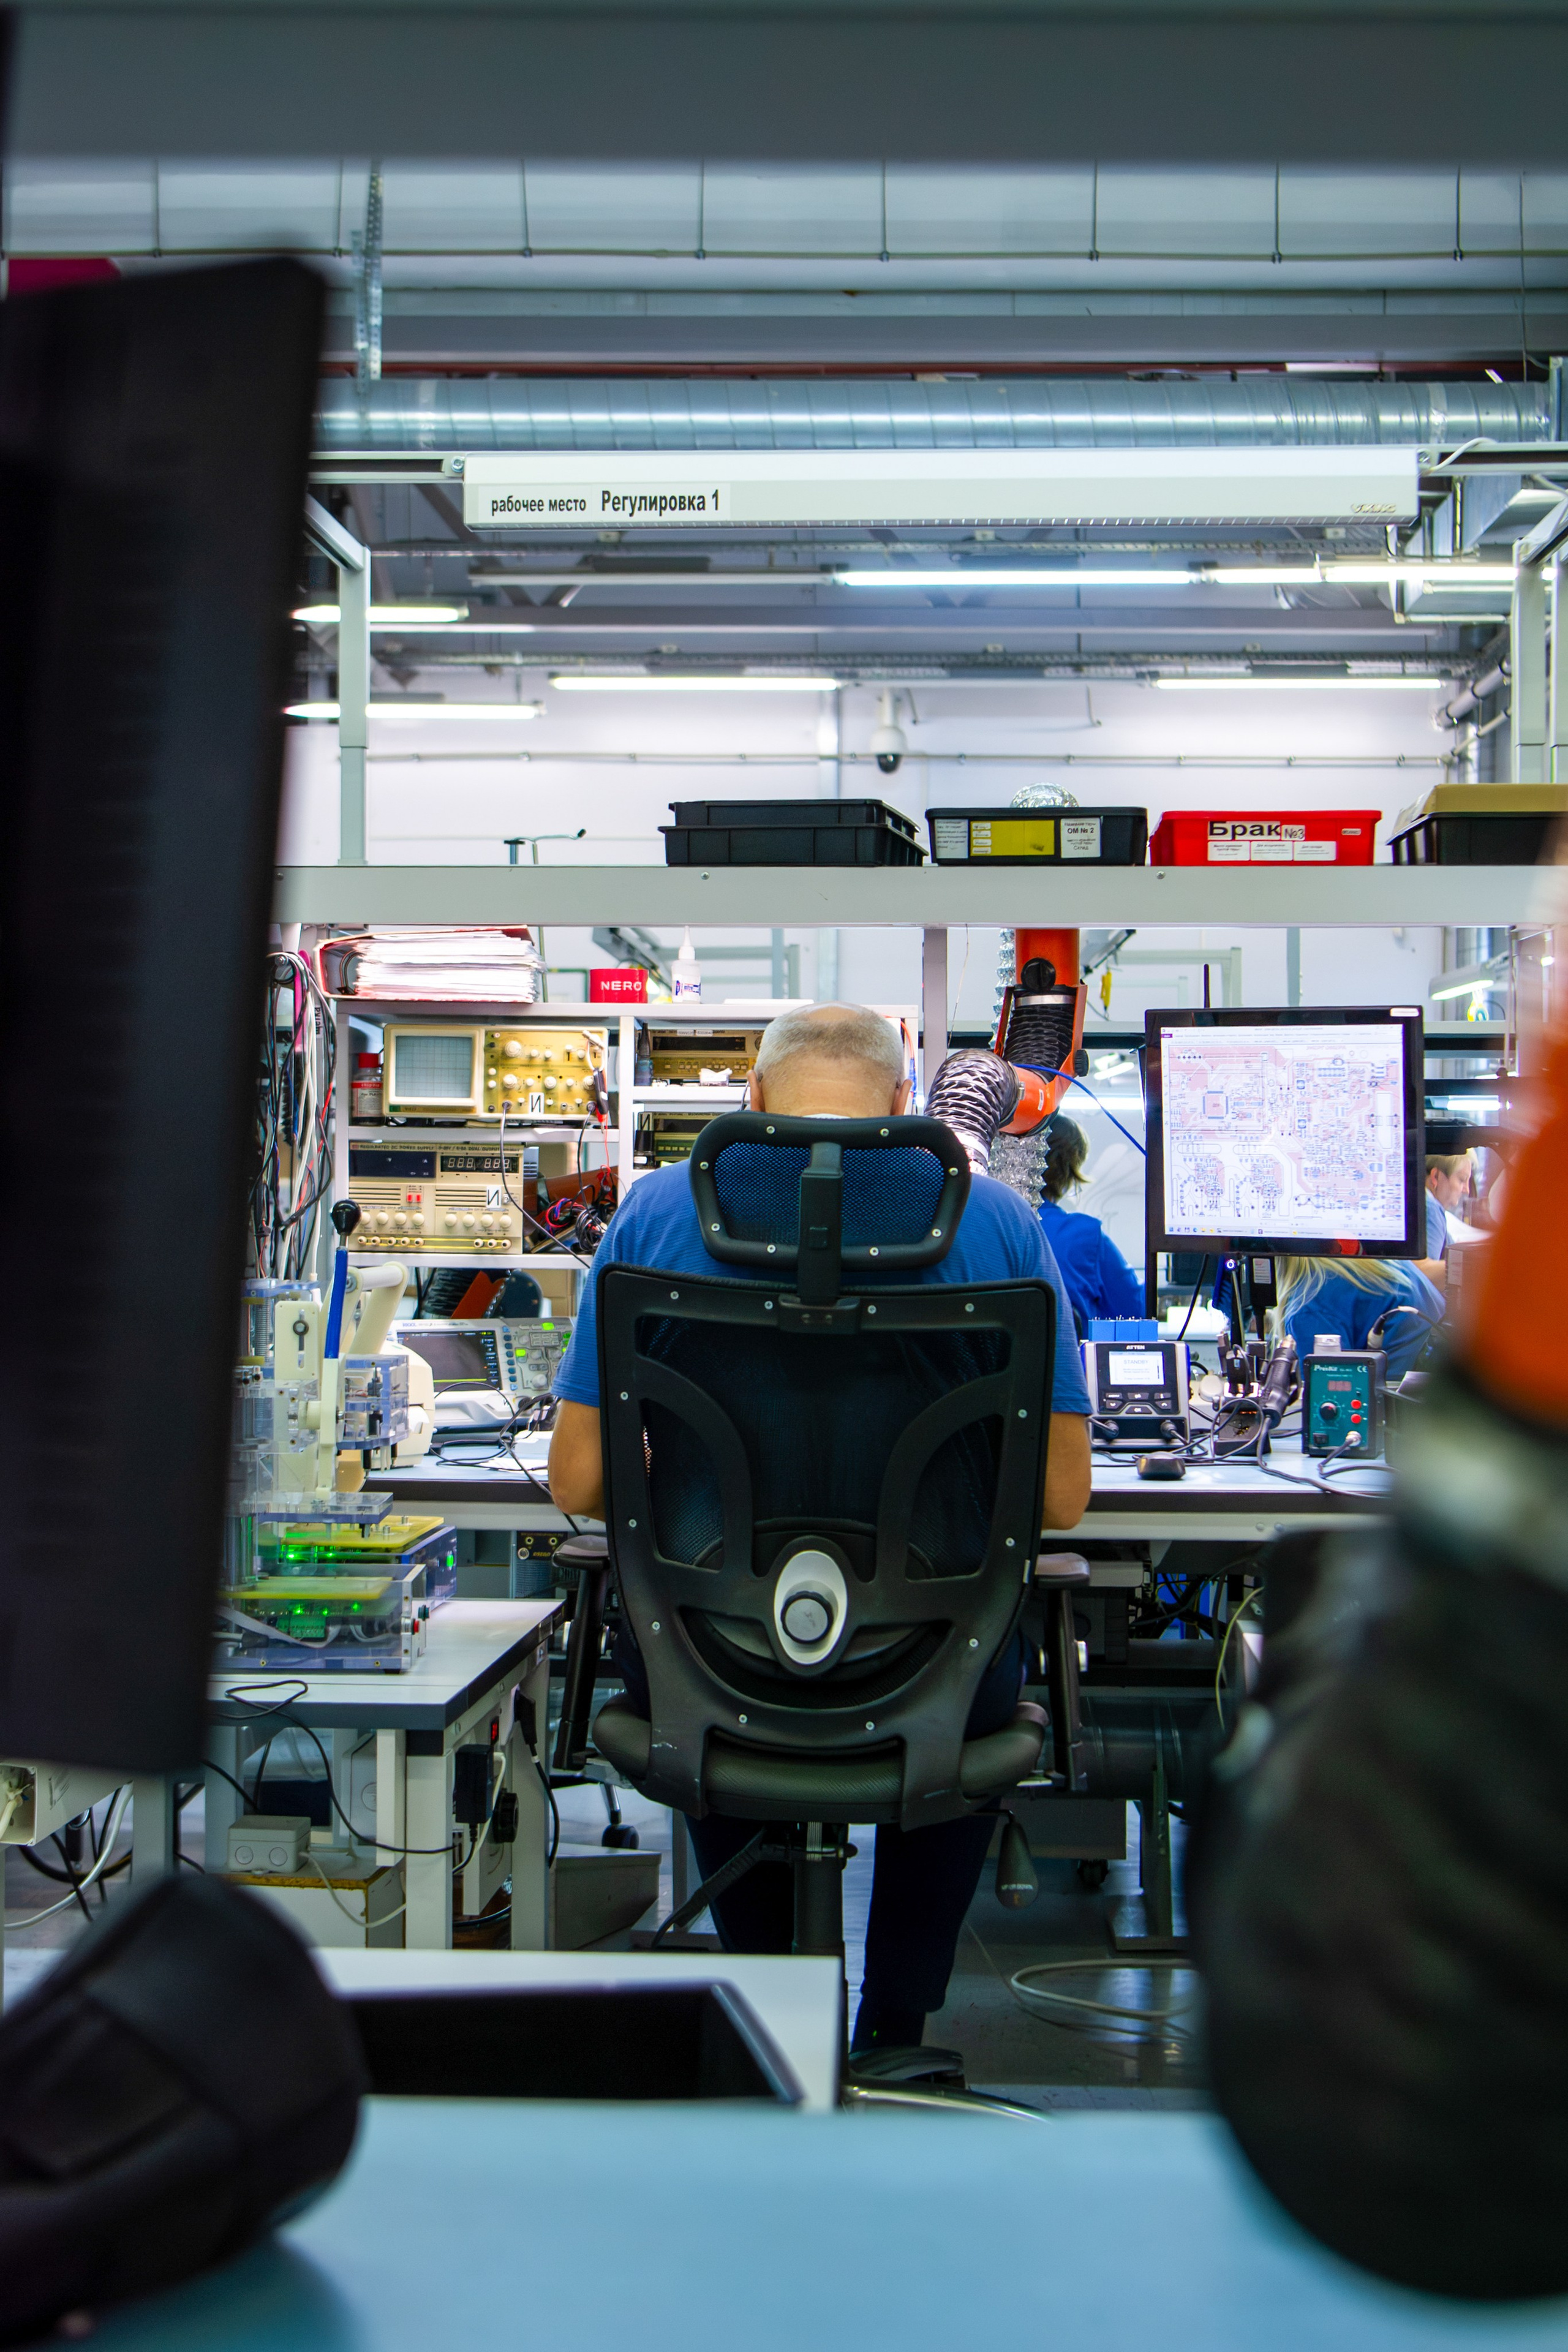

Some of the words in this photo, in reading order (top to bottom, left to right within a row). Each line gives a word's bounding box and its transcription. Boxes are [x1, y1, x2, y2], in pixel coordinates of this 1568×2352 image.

[491, 496, 545, 515] рабочее
[548, 497, 587, 512] место
[601, 490, 706, 516] Регулировка
[711, 489, 720, 511] 1
[1208, 821, 1280, 840] Брак
[1284, 828, 1304, 840] №3
[601, 981, 642, 991] NERO
